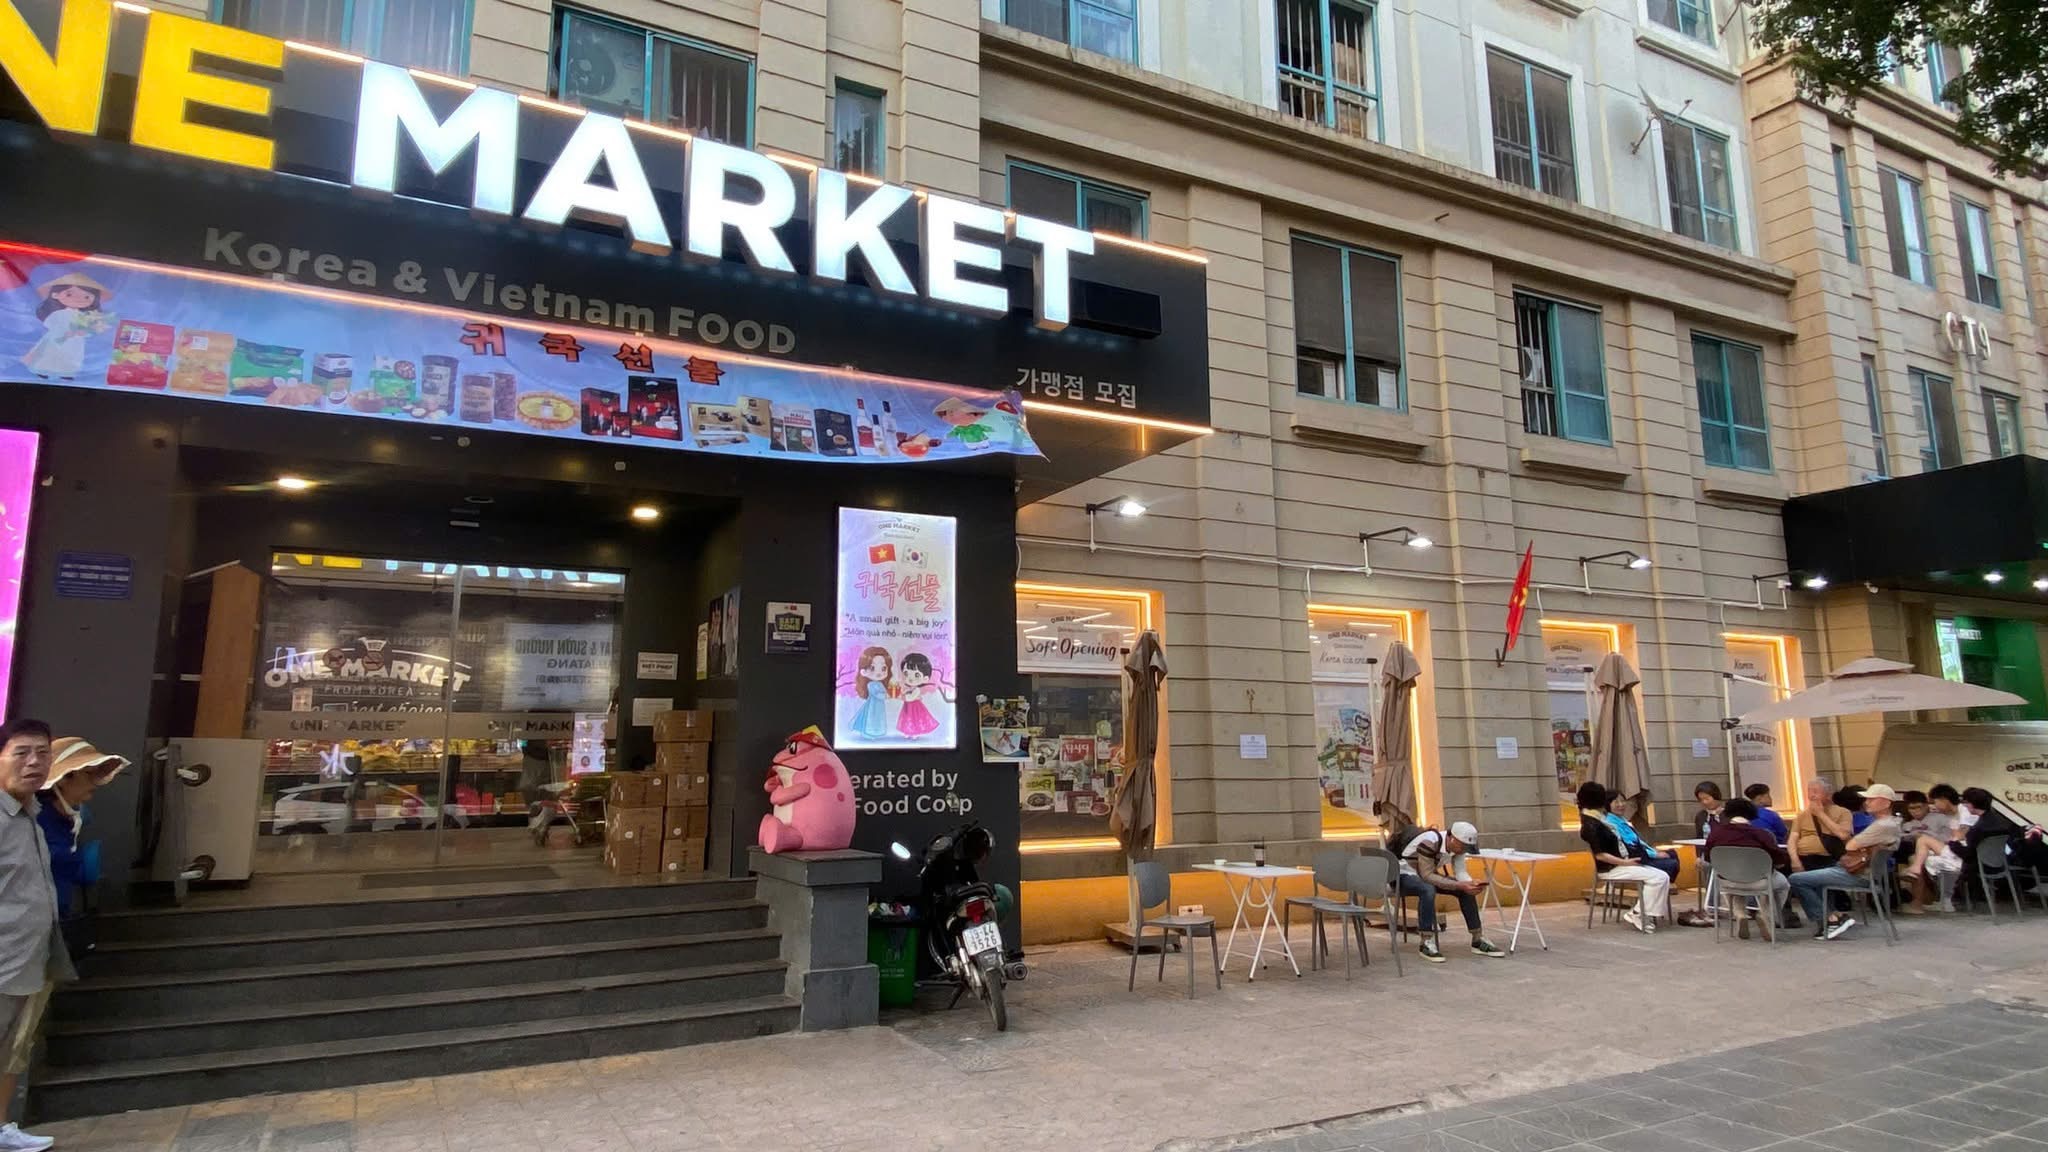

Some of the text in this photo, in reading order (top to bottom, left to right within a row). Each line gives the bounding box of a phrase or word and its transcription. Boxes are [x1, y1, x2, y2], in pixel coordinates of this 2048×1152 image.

[351, 58, 1095, 331] MARKET
[203, 227, 797, 354] Korea & Vietnam FOOD
[1945, 312, 1992, 360] CT9
[1016, 367, 1137, 409] 가맹점 모집
[860, 616, 883, 624] small
[885, 616, 900, 626] gift
[916, 617, 929, 628] big
[1060, 638, 1117, 661] Opening
[369, 685, 415, 697] KOREA
[932, 768, 959, 790] by
[916, 795, 973, 815] Cop
